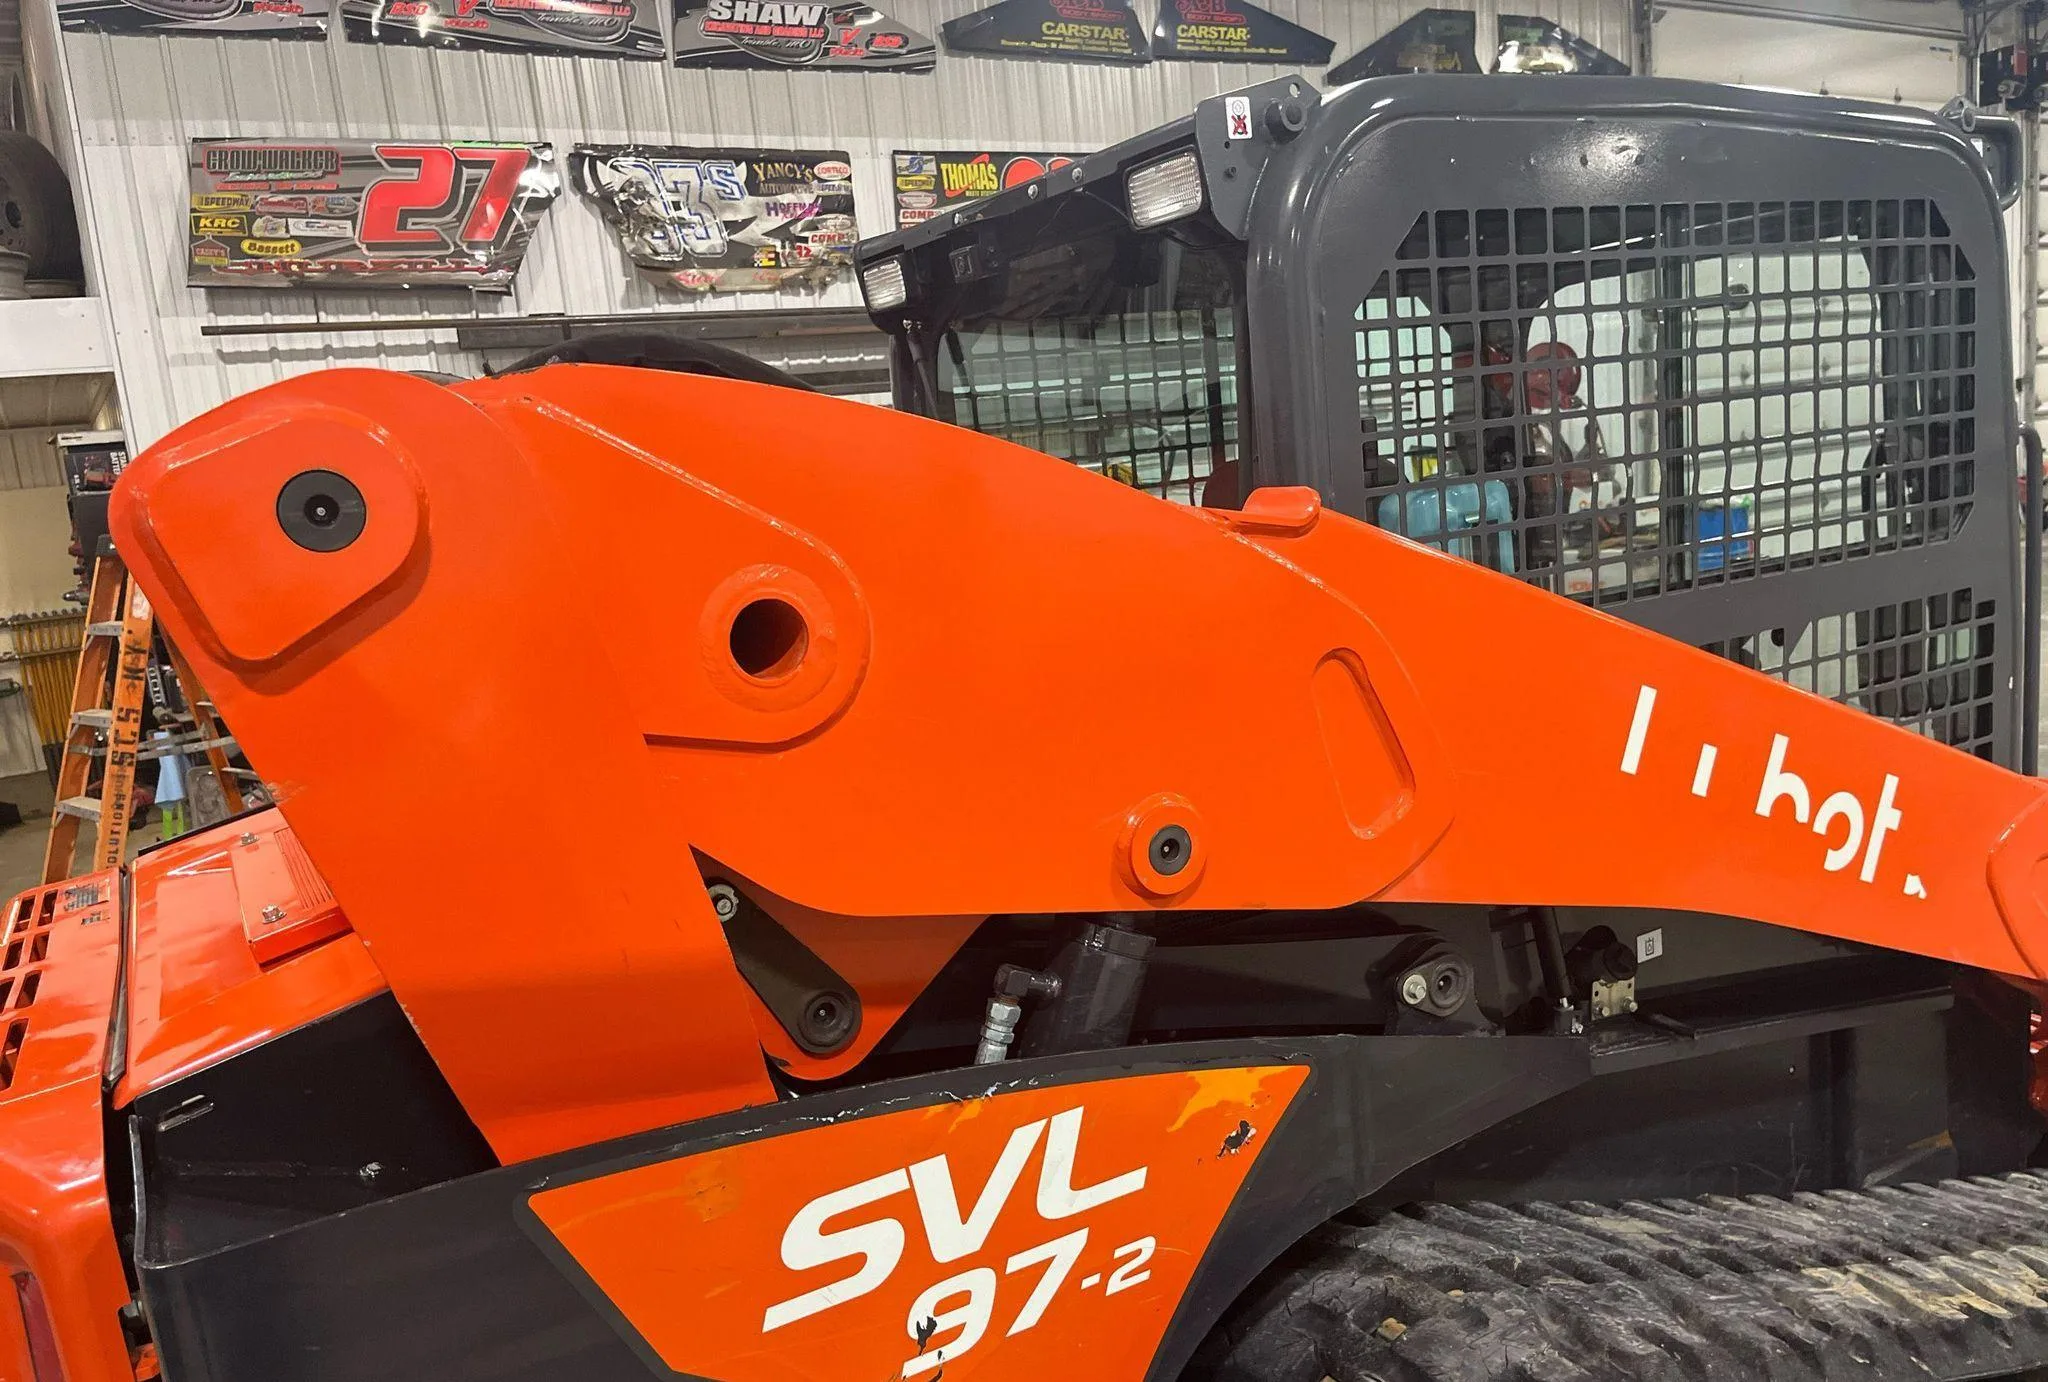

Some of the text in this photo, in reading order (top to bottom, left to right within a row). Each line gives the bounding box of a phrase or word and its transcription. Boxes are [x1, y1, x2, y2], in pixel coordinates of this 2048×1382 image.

[709, 0, 824, 25] SHAW
[1041, 21, 1126, 39] CARSTAR
[1177, 24, 1247, 40] CARSTAR
[940, 163, 998, 190] THOMAS
[359, 145, 531, 243] 27
[199, 217, 241, 229] KRC
[902, 210, 935, 220] COMP
[811, 233, 845, 244] COMP
[247, 242, 296, 254] Bassett
[762, 1105, 1148, 1334] SVL
[902, 1226, 1157, 1379] 97-2
